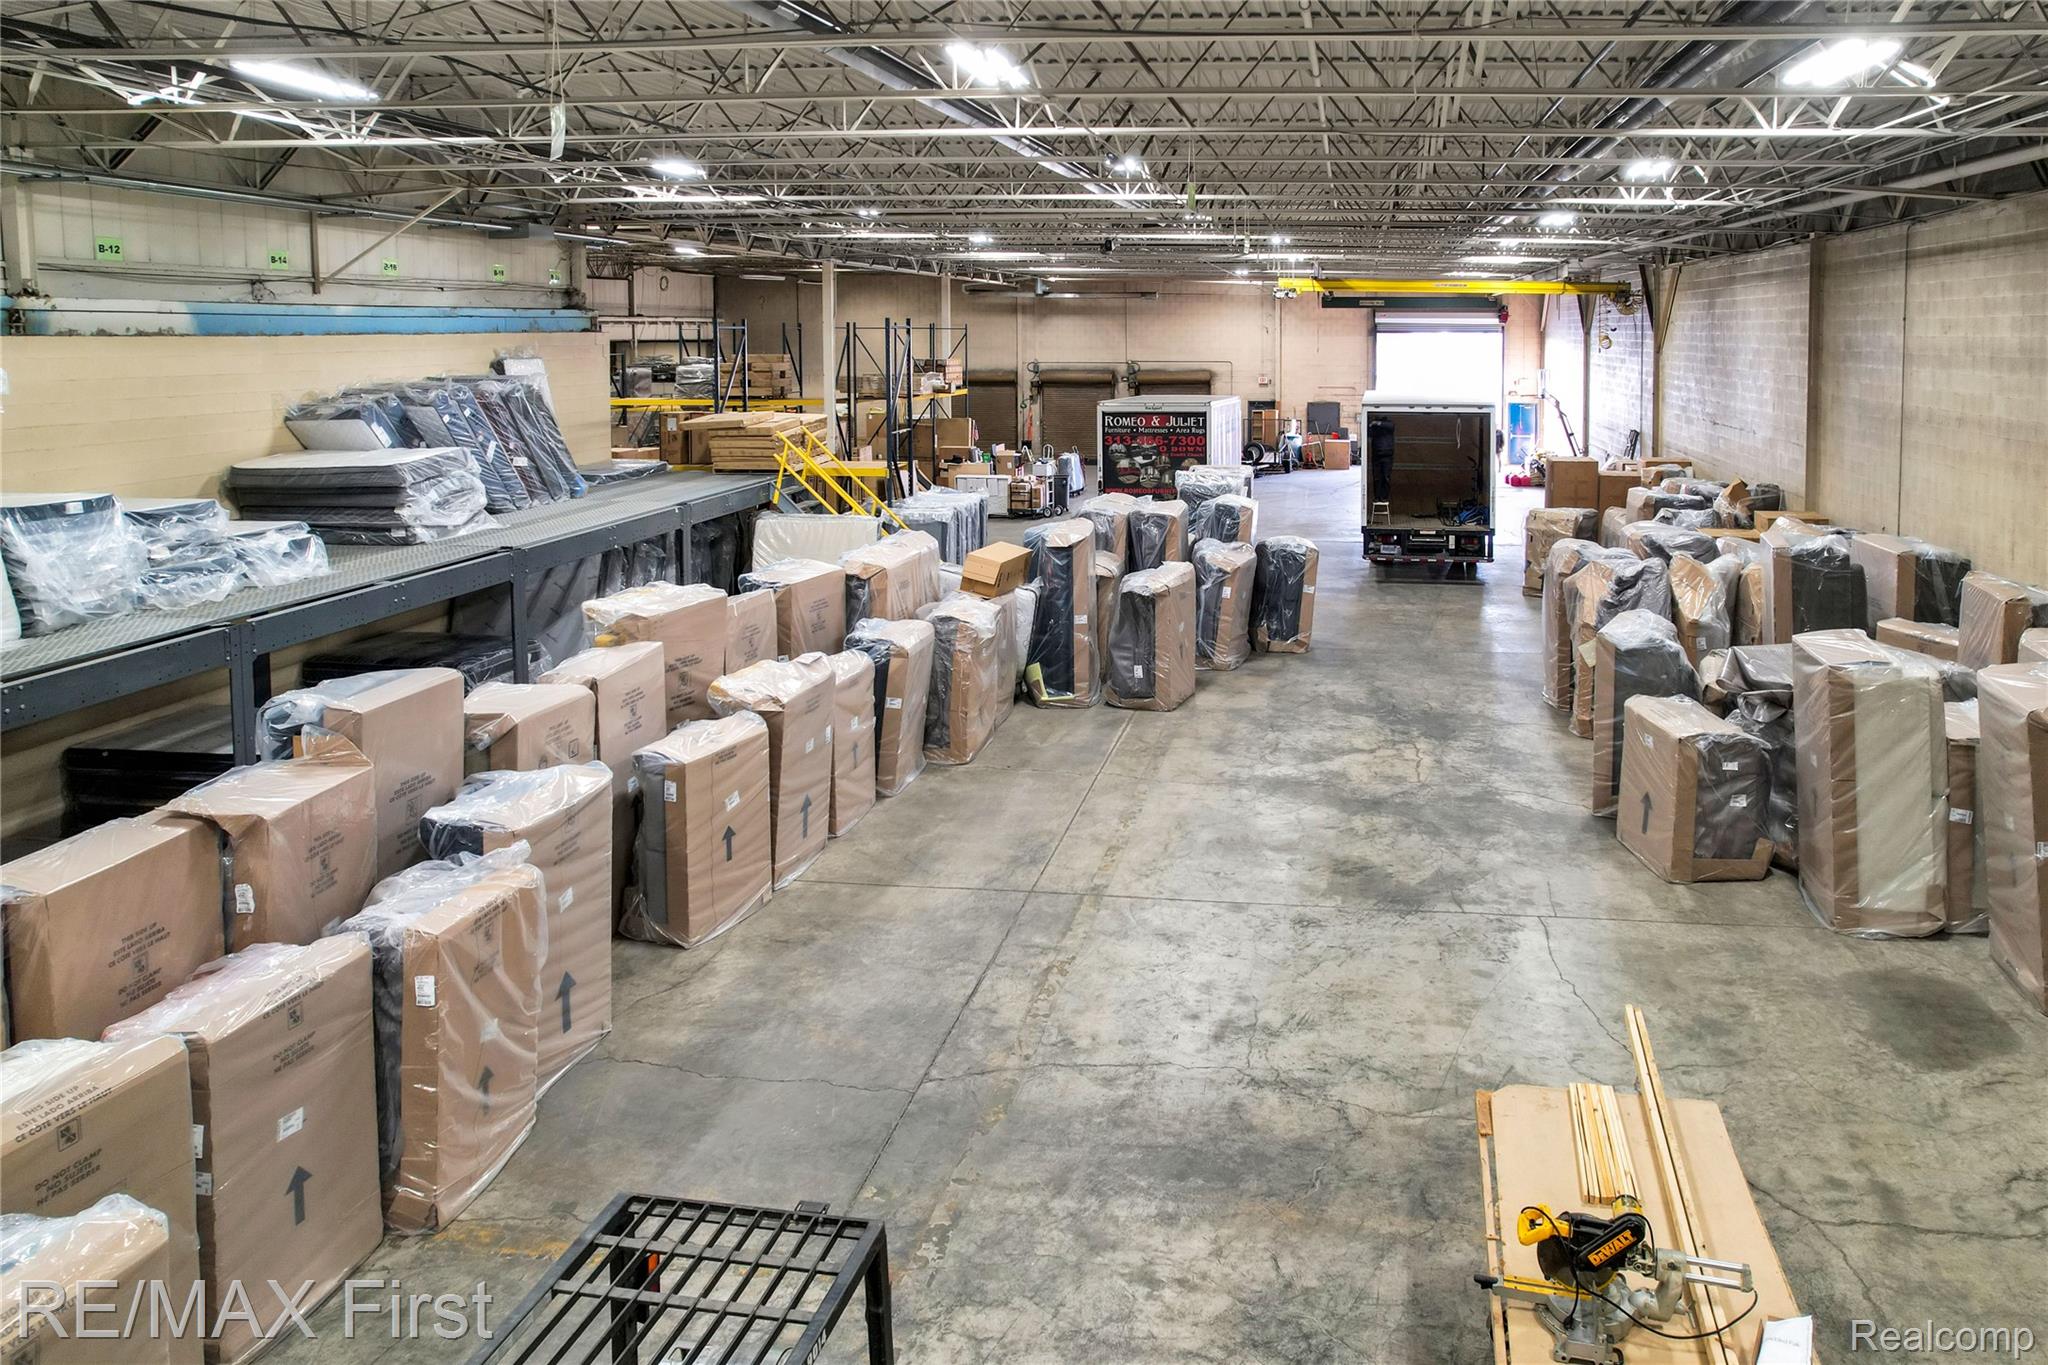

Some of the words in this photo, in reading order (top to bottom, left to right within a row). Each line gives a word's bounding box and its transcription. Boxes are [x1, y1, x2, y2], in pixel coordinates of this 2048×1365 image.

[98, 244, 121, 254] B-12
[271, 255, 287, 264] B-14
[1104, 415, 1146, 427] ROMEO
[1151, 415, 1160, 427] &
[1165, 415, 1205, 427] JULIET
[16, 1118, 38, 1131] ESTE
[40, 1103, 65, 1119] LADO
[66, 1085, 100, 1105] ARRIBA
[22, 1104, 44, 1118] THIS
[45, 1093, 65, 1106] SIDE
[66, 1085, 80, 1095] UP
[15, 1134, 26, 1143] CE
[53, 1108, 77, 1122] VERS
[78, 1100, 88, 1110] LE
[88, 1087, 112, 1104] HAUT
[35, 1178, 49, 1192] DO
[52, 1166, 72, 1180] NOT
[73, 1148, 102, 1169] CLAMP
[46, 1180, 62, 1193] NO
[51, 1184, 69, 1199] PAS
